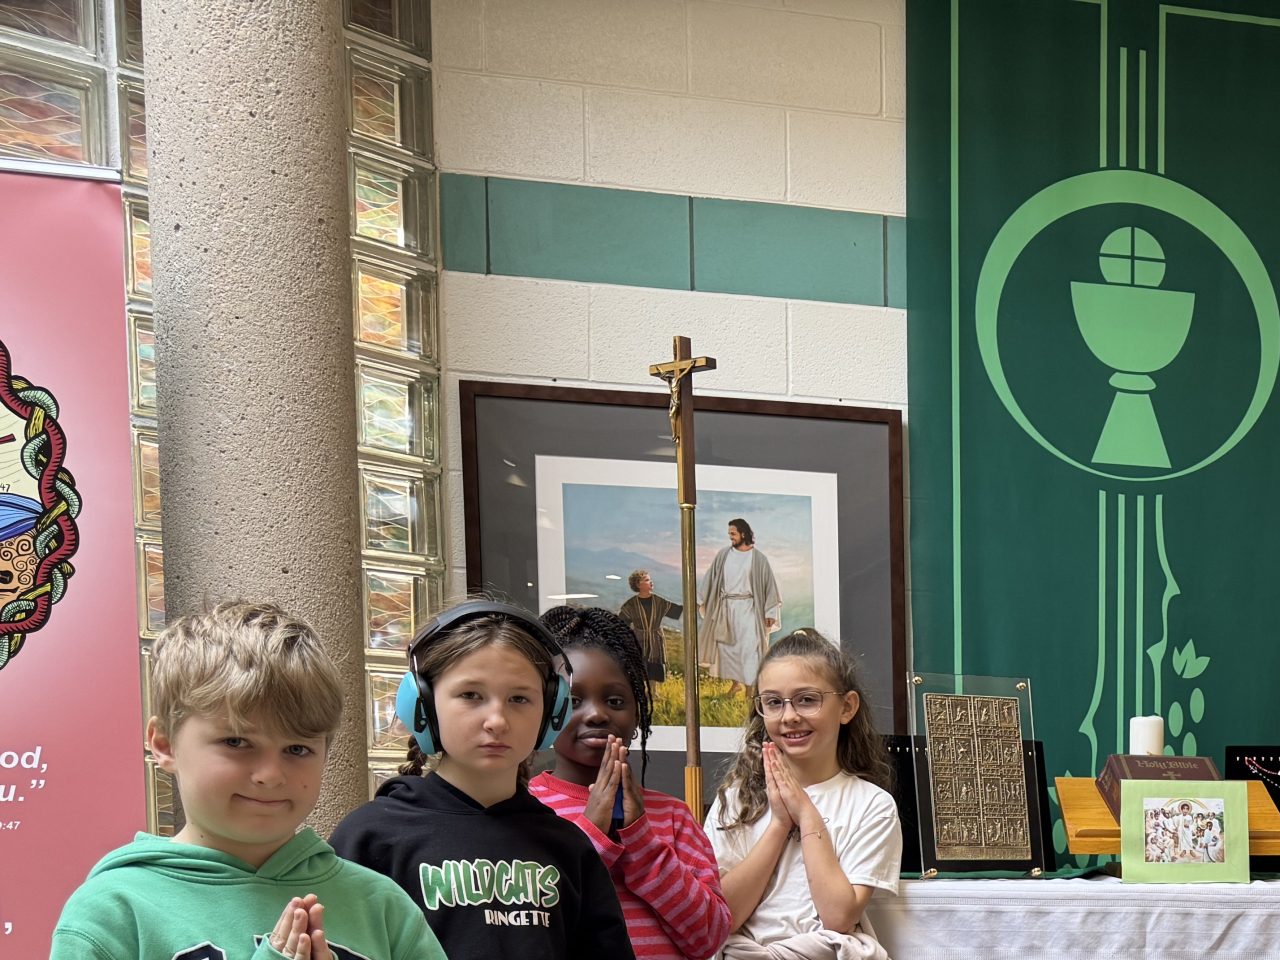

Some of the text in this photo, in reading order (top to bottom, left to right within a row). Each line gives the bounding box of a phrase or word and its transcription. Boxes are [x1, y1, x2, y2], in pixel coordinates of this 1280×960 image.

[1136, 760, 1200, 770] Holy Bible
[419, 858, 561, 910] WILDCATS
[484, 909, 551, 927] RINGETTE
